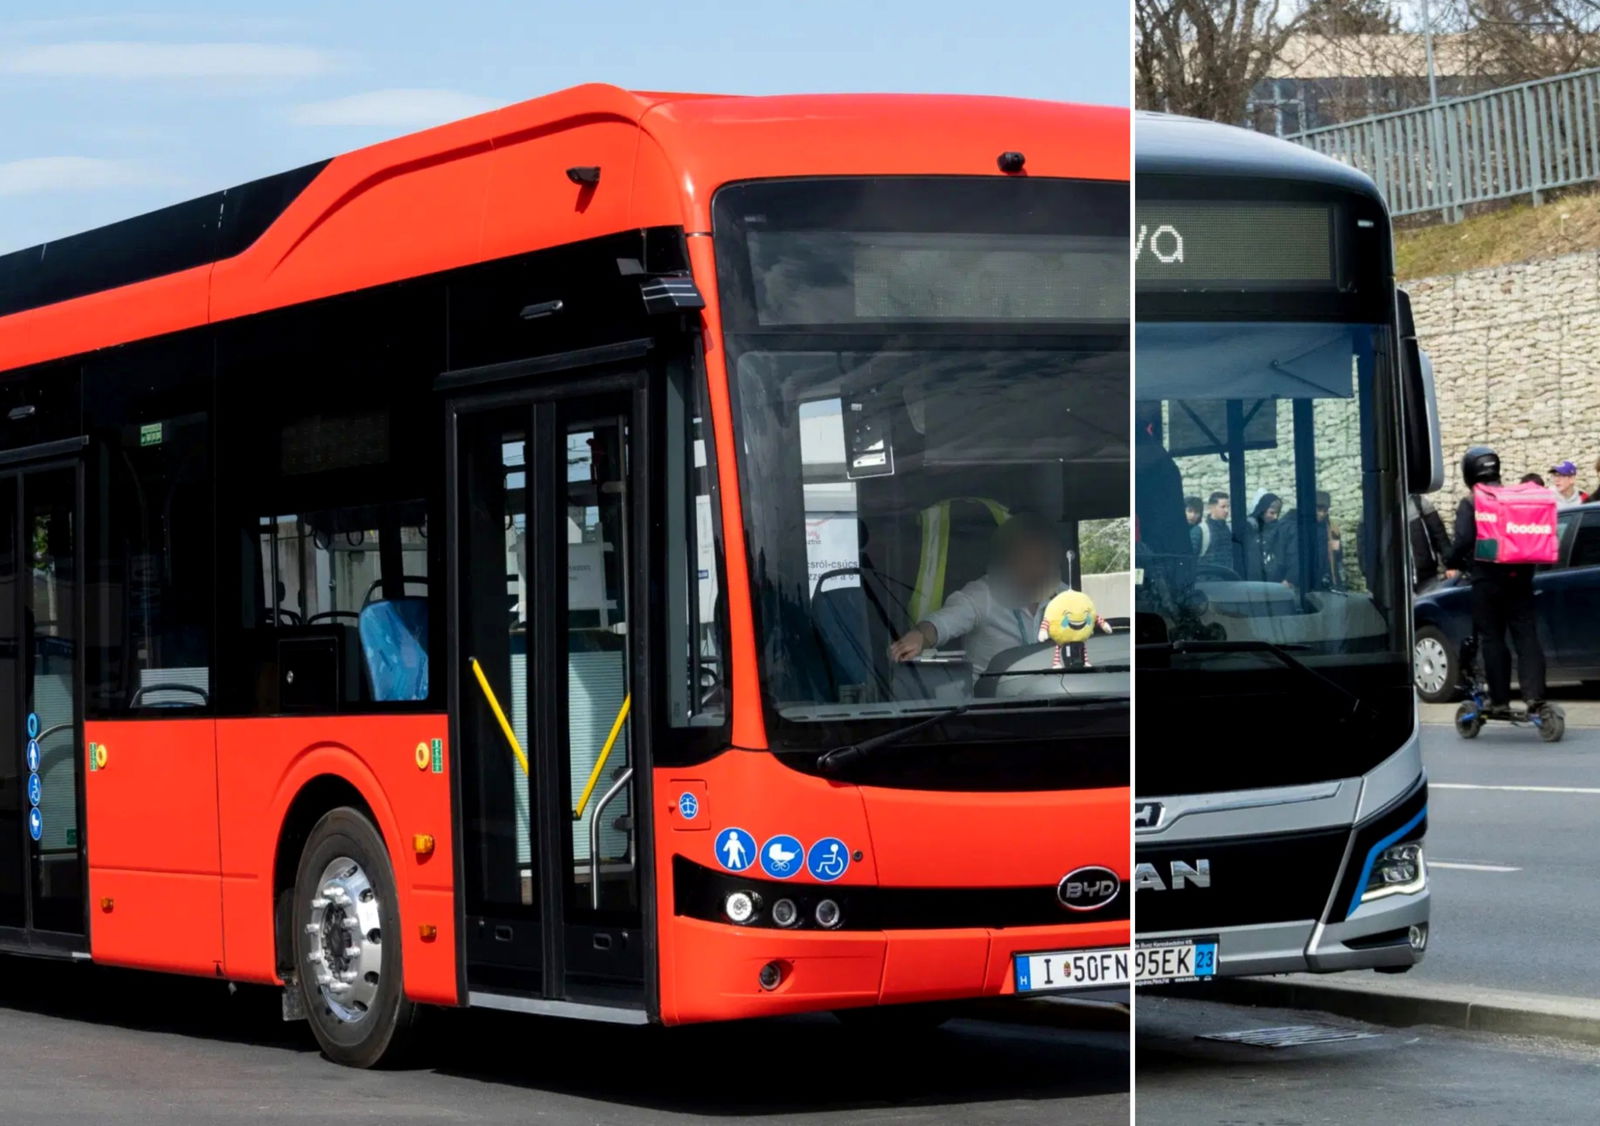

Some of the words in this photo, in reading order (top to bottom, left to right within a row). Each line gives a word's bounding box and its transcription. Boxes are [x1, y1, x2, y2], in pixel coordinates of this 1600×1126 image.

[1066, 880, 1115, 898] BYD
[1073, 953, 1129, 982] 50FN
[1135, 948, 1191, 977] 95EK
[1197, 951, 1214, 968] 23
[1020, 975, 1029, 986] H
